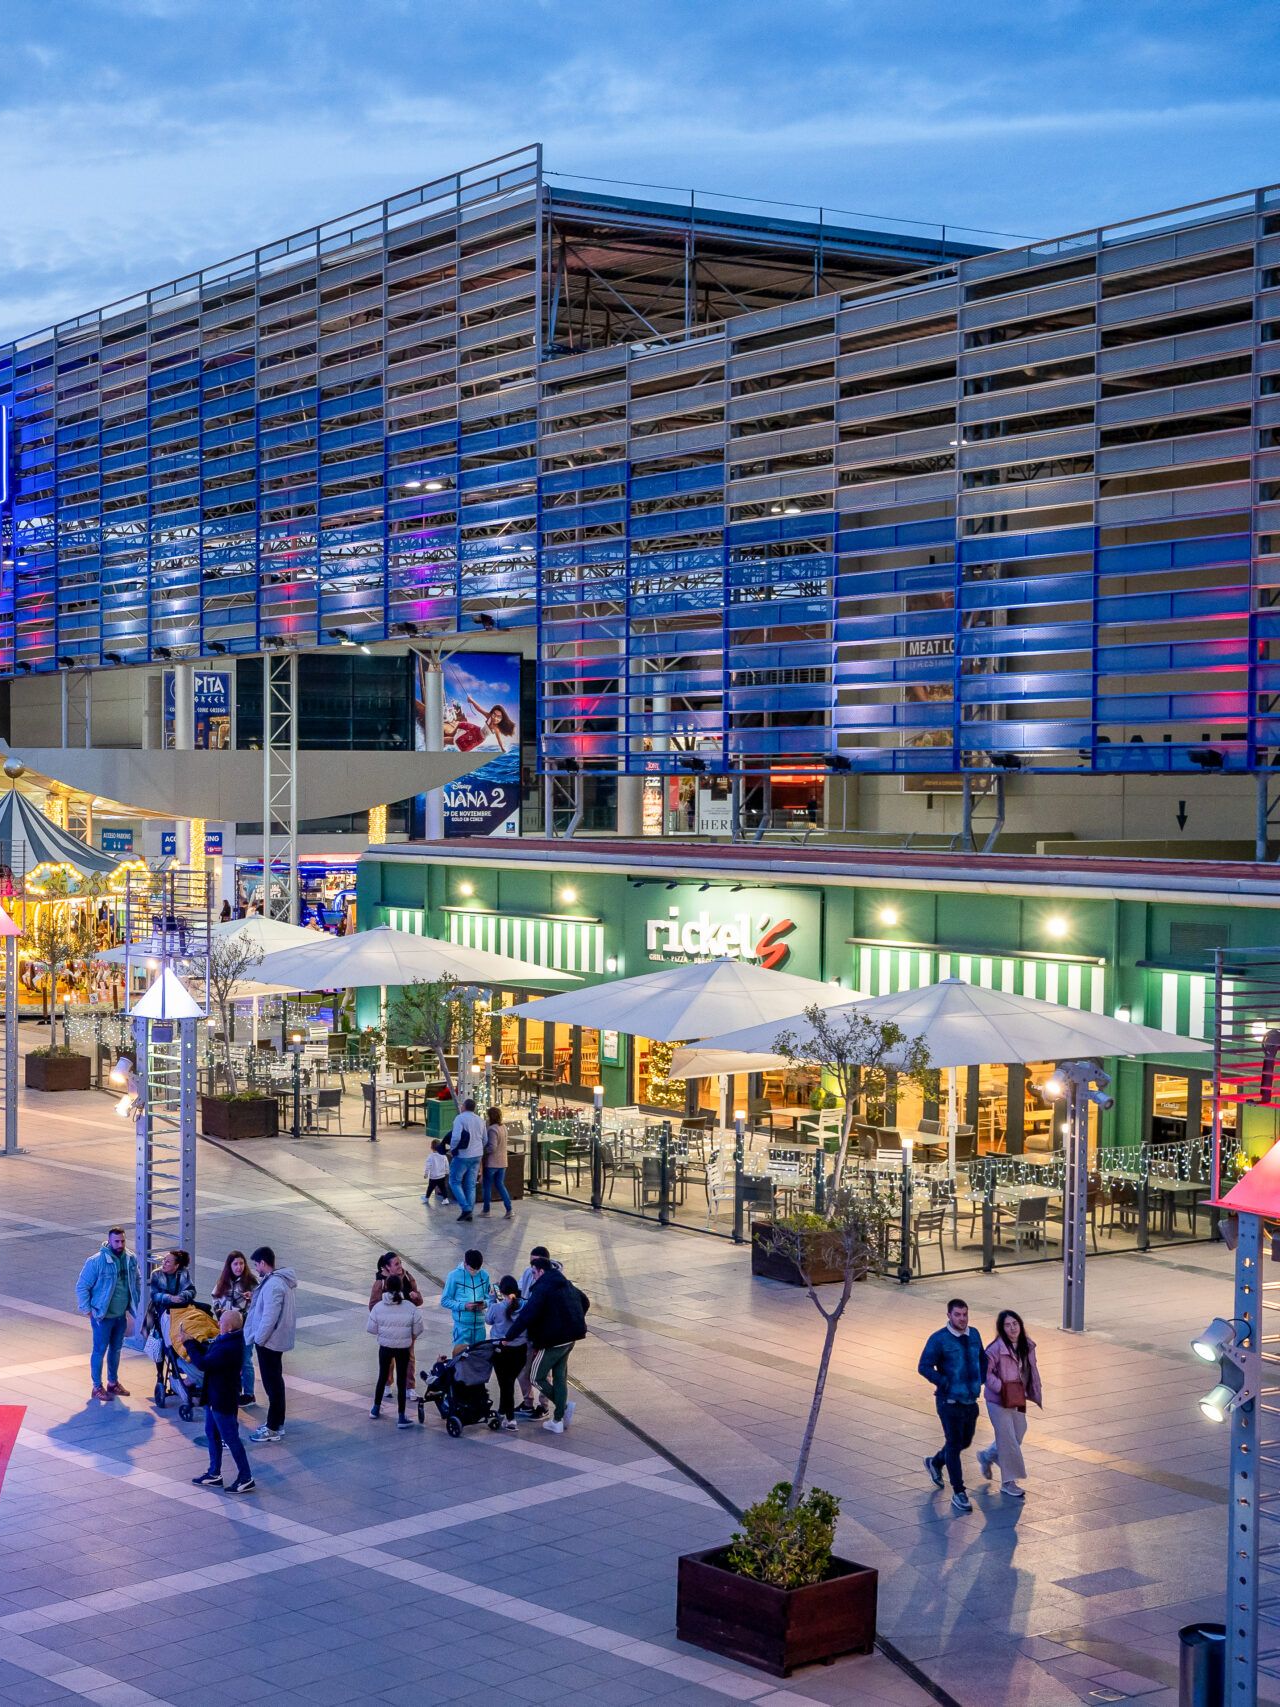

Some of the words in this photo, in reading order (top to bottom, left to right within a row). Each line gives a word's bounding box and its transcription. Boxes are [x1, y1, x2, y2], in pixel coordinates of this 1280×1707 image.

[910, 641, 940, 656] MEAT
[195, 676, 225, 693] PITA
[451, 781, 472, 792] Disney
[443, 791, 489, 808] AIANA
[489, 787, 507, 808] 2
[646, 906, 794, 969] rickel's
